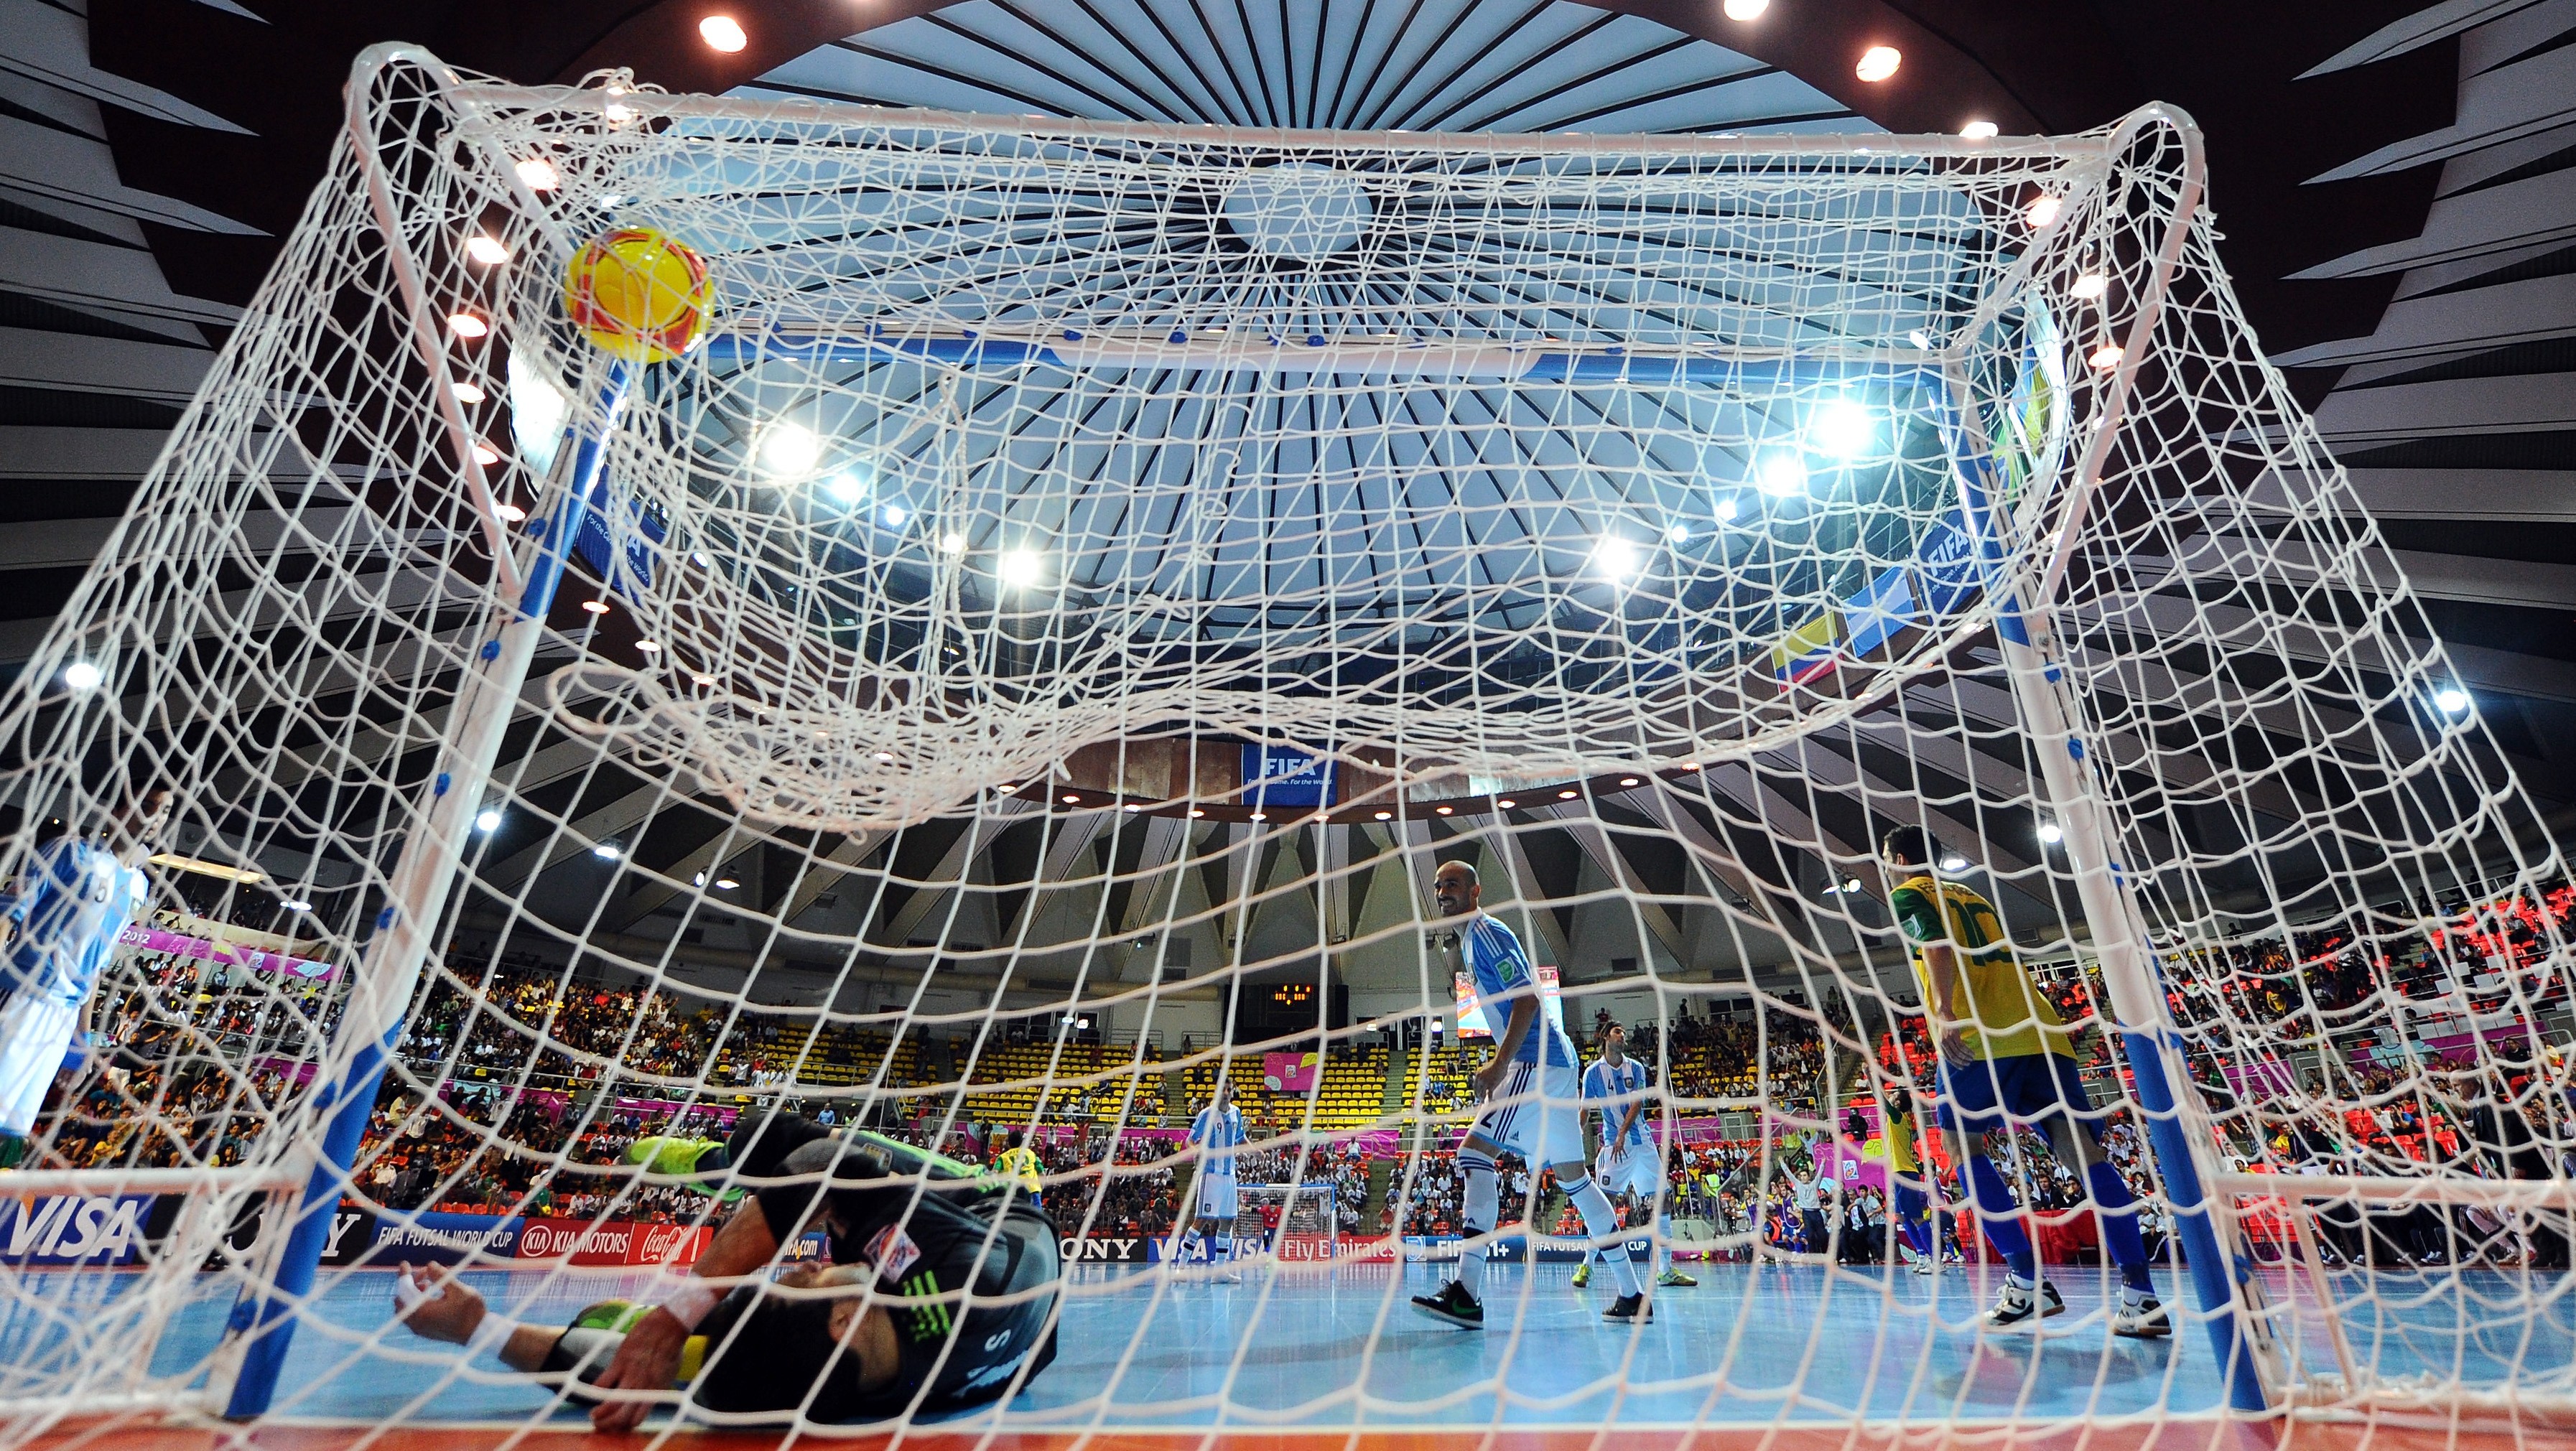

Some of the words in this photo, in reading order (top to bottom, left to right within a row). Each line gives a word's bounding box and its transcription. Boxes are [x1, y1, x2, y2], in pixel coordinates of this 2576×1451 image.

[1928, 525, 1968, 577] FIFA
[1264, 758, 1316, 775] FIFA
[121, 930, 151, 944] 2012
[1947, 897, 2023, 966] 10
[1608, 1078, 1614, 1091] 4
[1217, 1122, 1222, 1134] 9
[8, 1193, 138, 1257] VISA
[377, 1226, 404, 1246] FIFA
[406, 1228, 450, 1246] FUTSAL
[451, 1230, 490, 1247] WORLD
[492, 1231, 513, 1248] CUP
[526, 1232, 546, 1250] KIA
[552, 1231, 575, 1253] KIA
[575, 1231, 628, 1254] MOTORS
[1532, 1242, 1551, 1251] FIFA
[1628, 1241, 1647, 1251] CUP
[1059, 1237, 1138, 1259] ONY
[1284, 1238, 1314, 1261] Fly
[1319, 1238, 1397, 1257] Emirates
[1437, 1240, 1464, 1256] FIF
